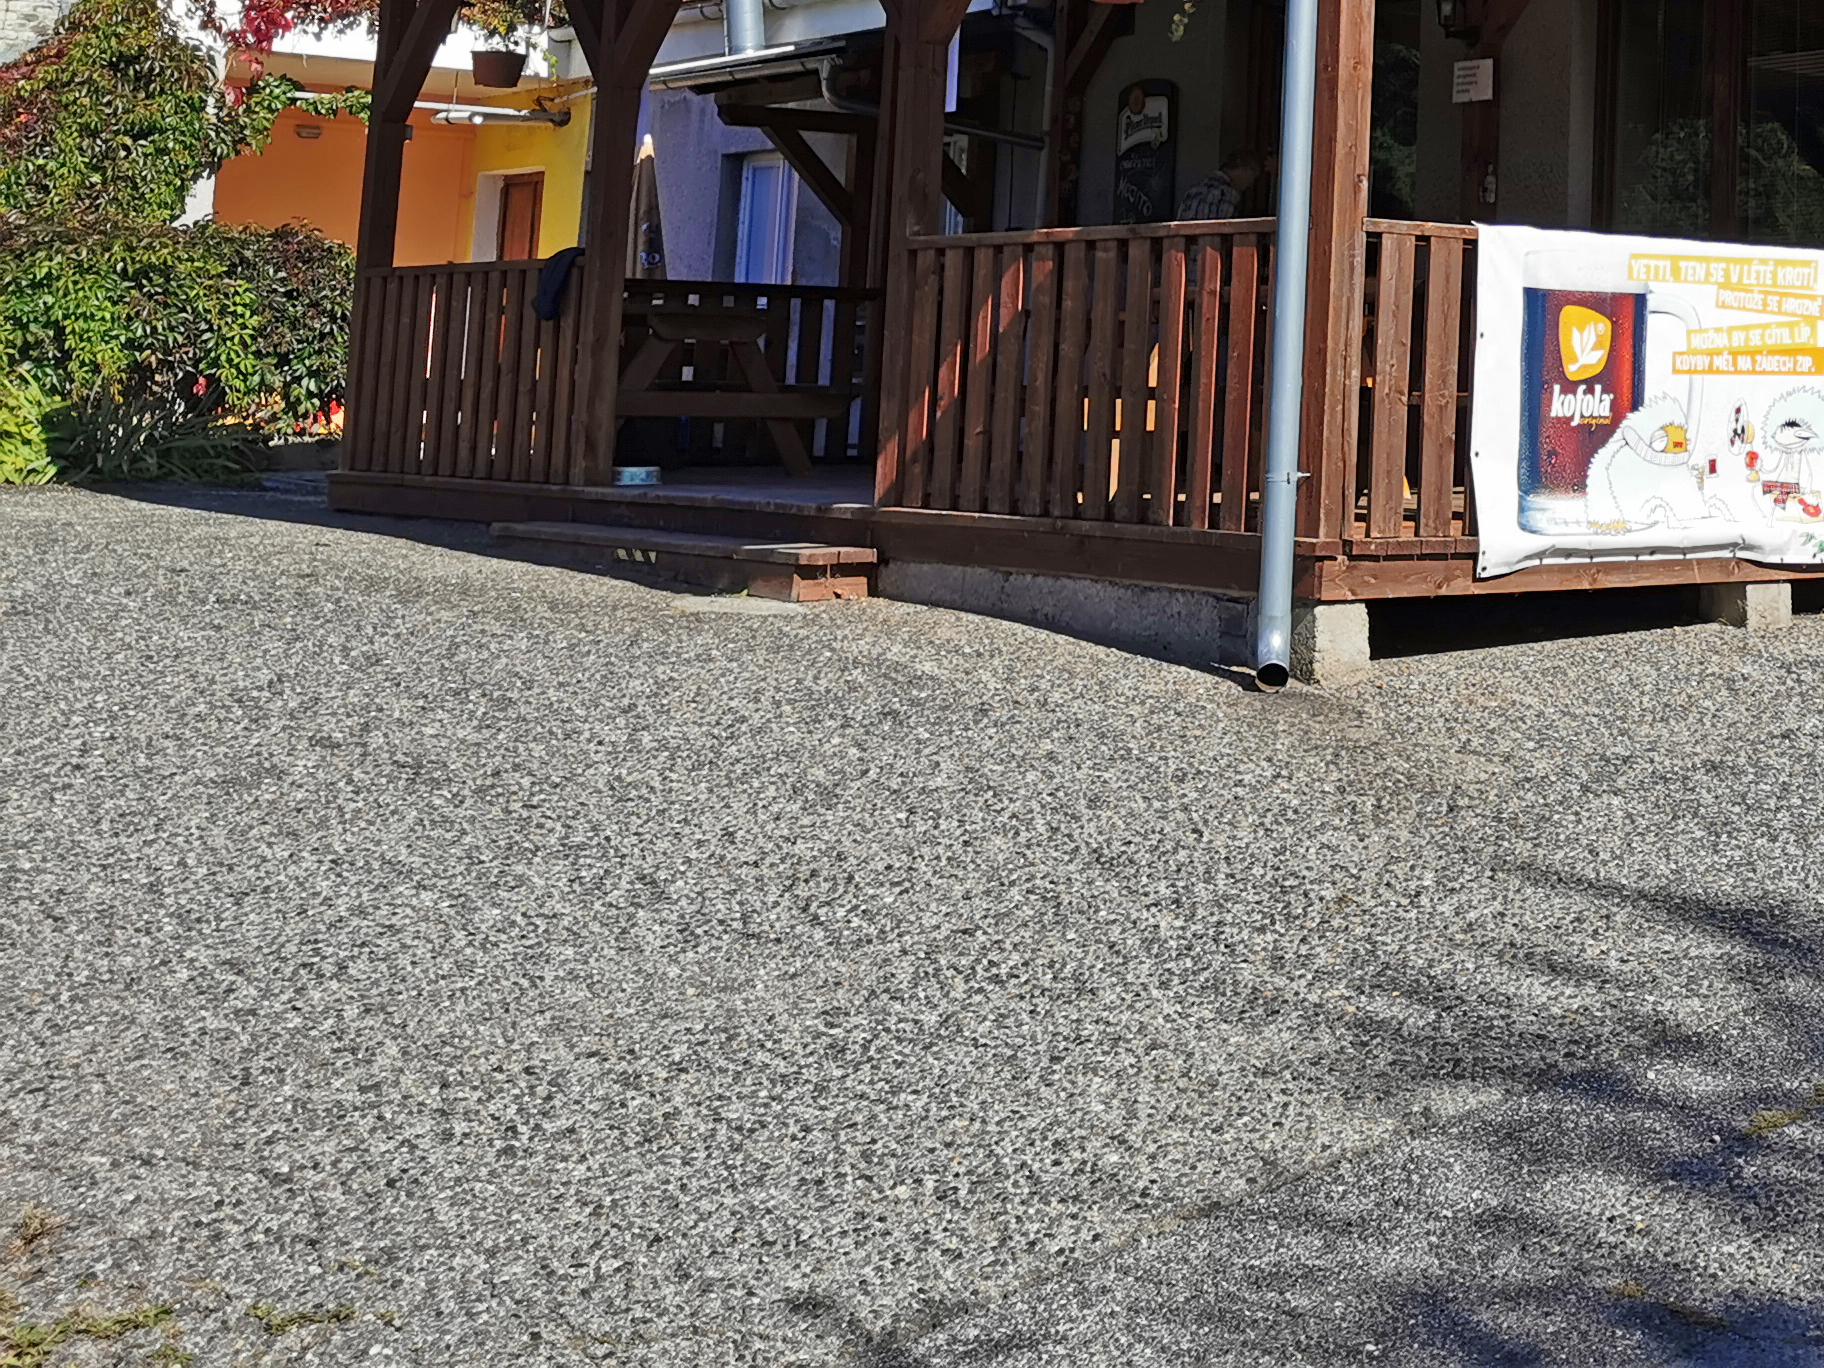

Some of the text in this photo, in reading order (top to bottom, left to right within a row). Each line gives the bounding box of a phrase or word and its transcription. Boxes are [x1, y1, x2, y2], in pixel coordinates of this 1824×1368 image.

[1630, 258, 1674, 283] YETTI,
[1679, 260, 1706, 282] TEN
[1709, 261, 1727, 283] SE
[1729, 263, 1742, 284] V
[1777, 262, 1818, 290] KROTÍ,
[1718, 289, 1764, 311] PROTOŽE
[1767, 296, 1779, 312] SE
[1781, 296, 1823, 317] HROZNĚ
[1690, 328, 1730, 350] MOŽNÁ
[1731, 331, 1747, 347] BY
[1749, 330, 1763, 346] SE
[1765, 325, 1793, 345] CÍTIL
[1675, 354, 1711, 371] KDYBY
[1737, 355, 1753, 371] NA
[1755, 351, 1794, 372] ZÁDECH
[1795, 355, 1816, 373] ZIP.
[1550, 384, 1613, 427] kofola
[1579, 412, 1613, 432] original
